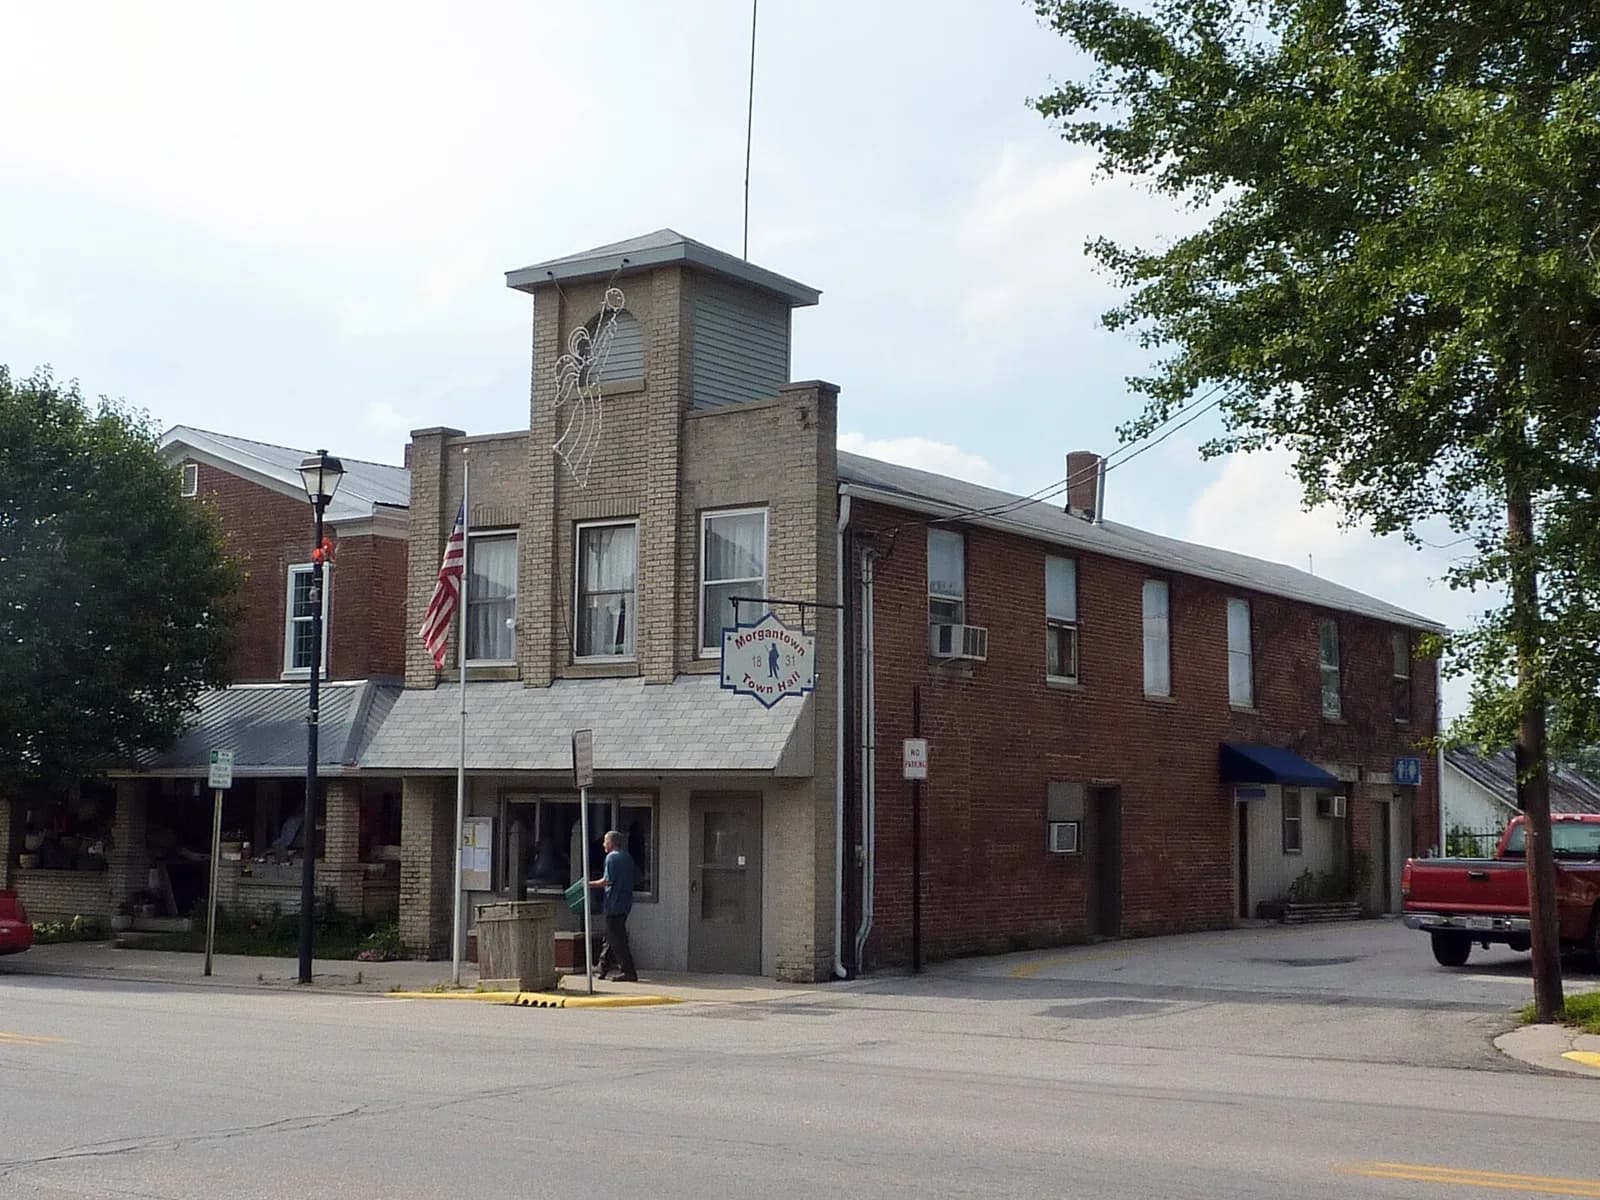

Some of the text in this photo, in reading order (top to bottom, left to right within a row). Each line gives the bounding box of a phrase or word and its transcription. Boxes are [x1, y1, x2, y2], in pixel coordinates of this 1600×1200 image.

[735, 629, 805, 656] Morgantown
[752, 655, 795, 668] 18 31
[742, 671, 801, 693] Town Hall
[910, 748, 920, 757] NO
